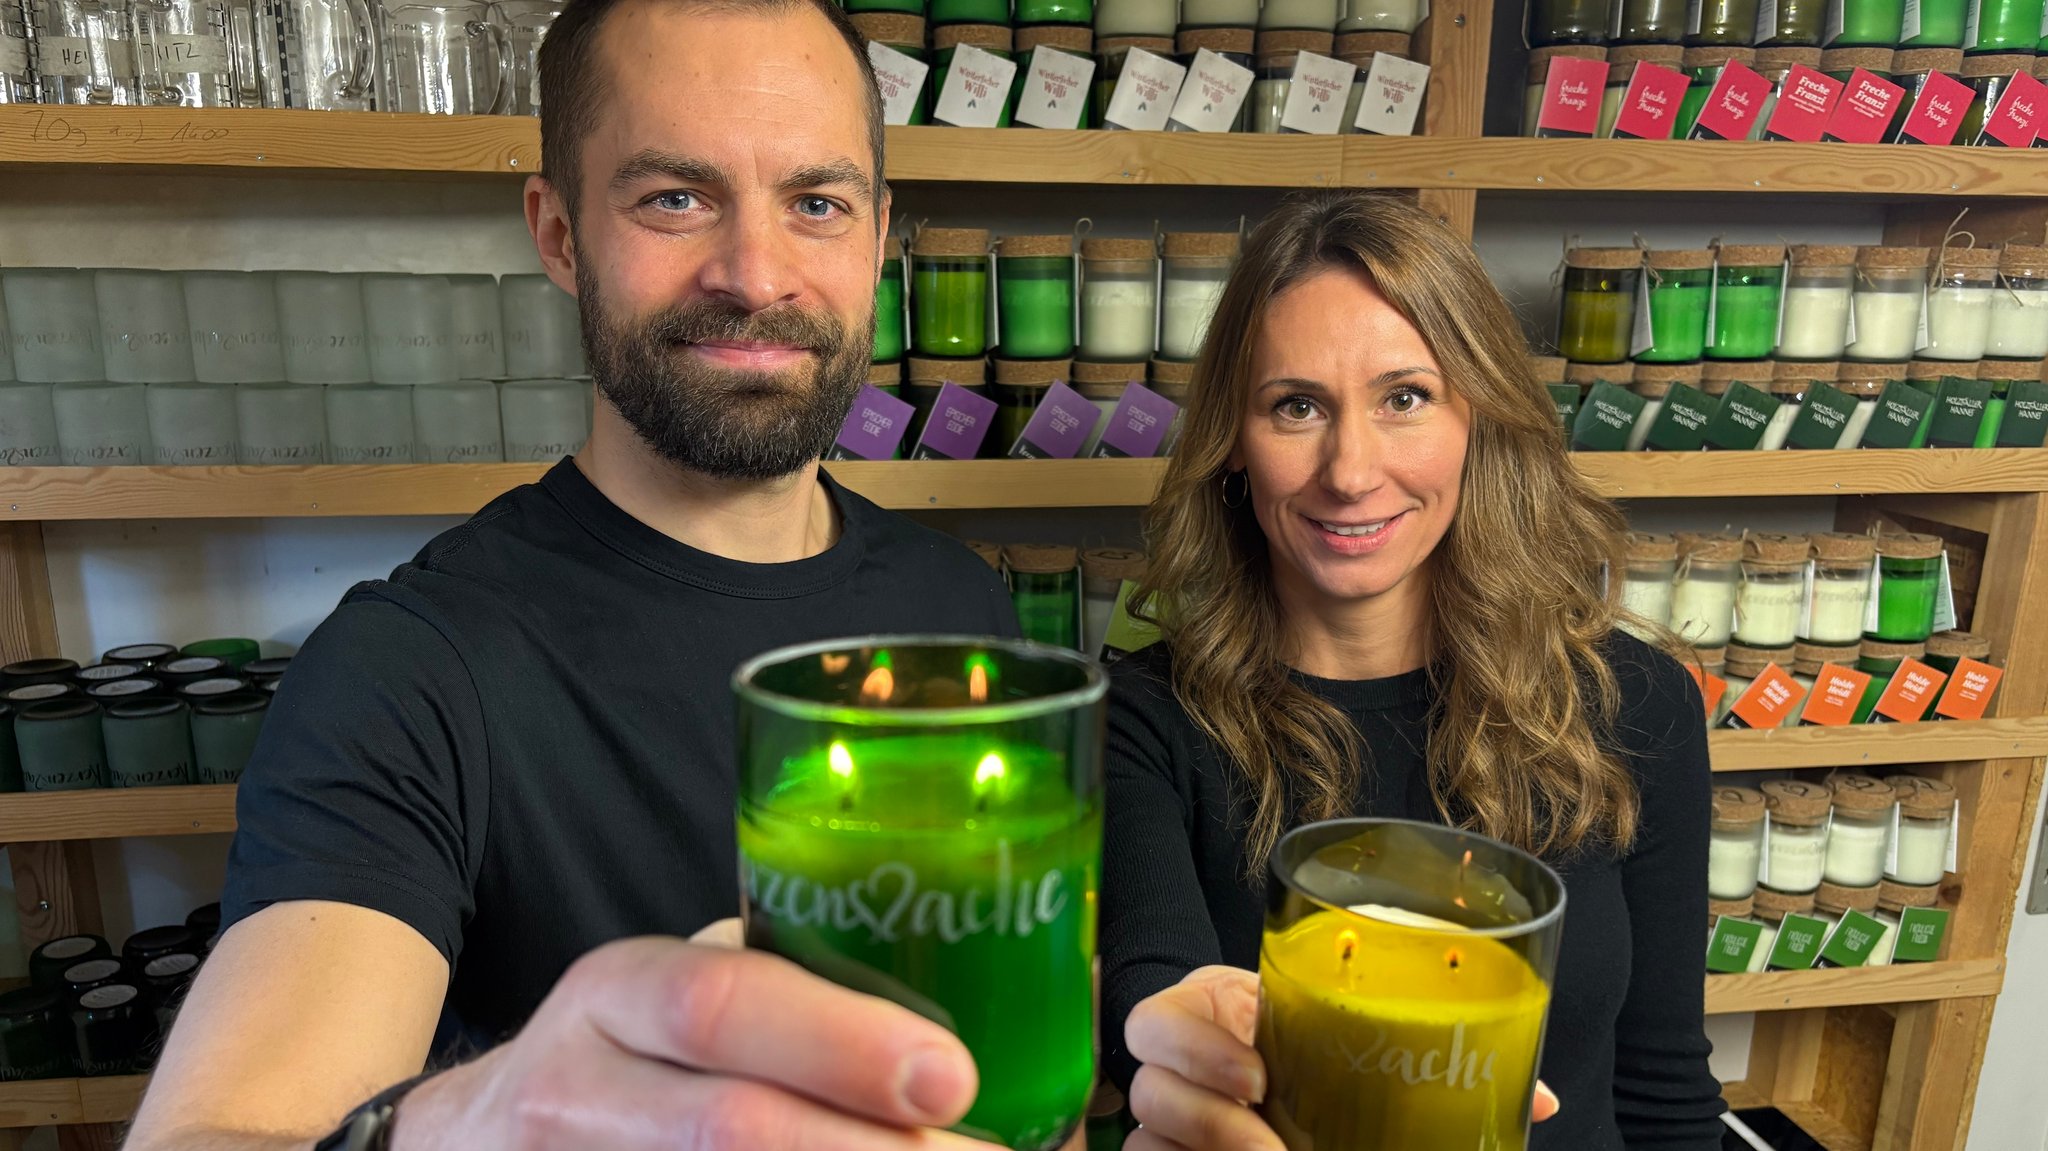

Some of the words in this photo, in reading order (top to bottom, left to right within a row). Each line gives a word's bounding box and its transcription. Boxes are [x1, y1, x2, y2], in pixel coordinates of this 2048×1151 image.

[1798, 76, 1830, 96] Freche
[1859, 80, 1891, 100] Freche
[1795, 86, 1827, 106] Franzi
[1854, 90, 1885, 110] Franzi
[1887, 411, 1911, 427] HANNE
[1949, 405, 1975, 417] HANNE
[2018, 410, 2042, 420] HANNE
[1596, 411, 1624, 430] HANNE
[1672, 413, 1699, 431] HANNE
[1731, 412, 1758, 430] HANNE
[1812, 413, 1837, 429] HANNE
[1829, 676, 1856, 689] Holde
[1906, 671, 1931, 687] Holde
[1965, 671, 1989, 684] Holde
[1768, 679, 1791, 699] Holde
[1827, 685, 1850, 698] Heidi
[1902, 679, 1926, 695] Heidi
[1962, 679, 1985, 693] Heidi
[1763, 687, 1785, 705] Heidi
